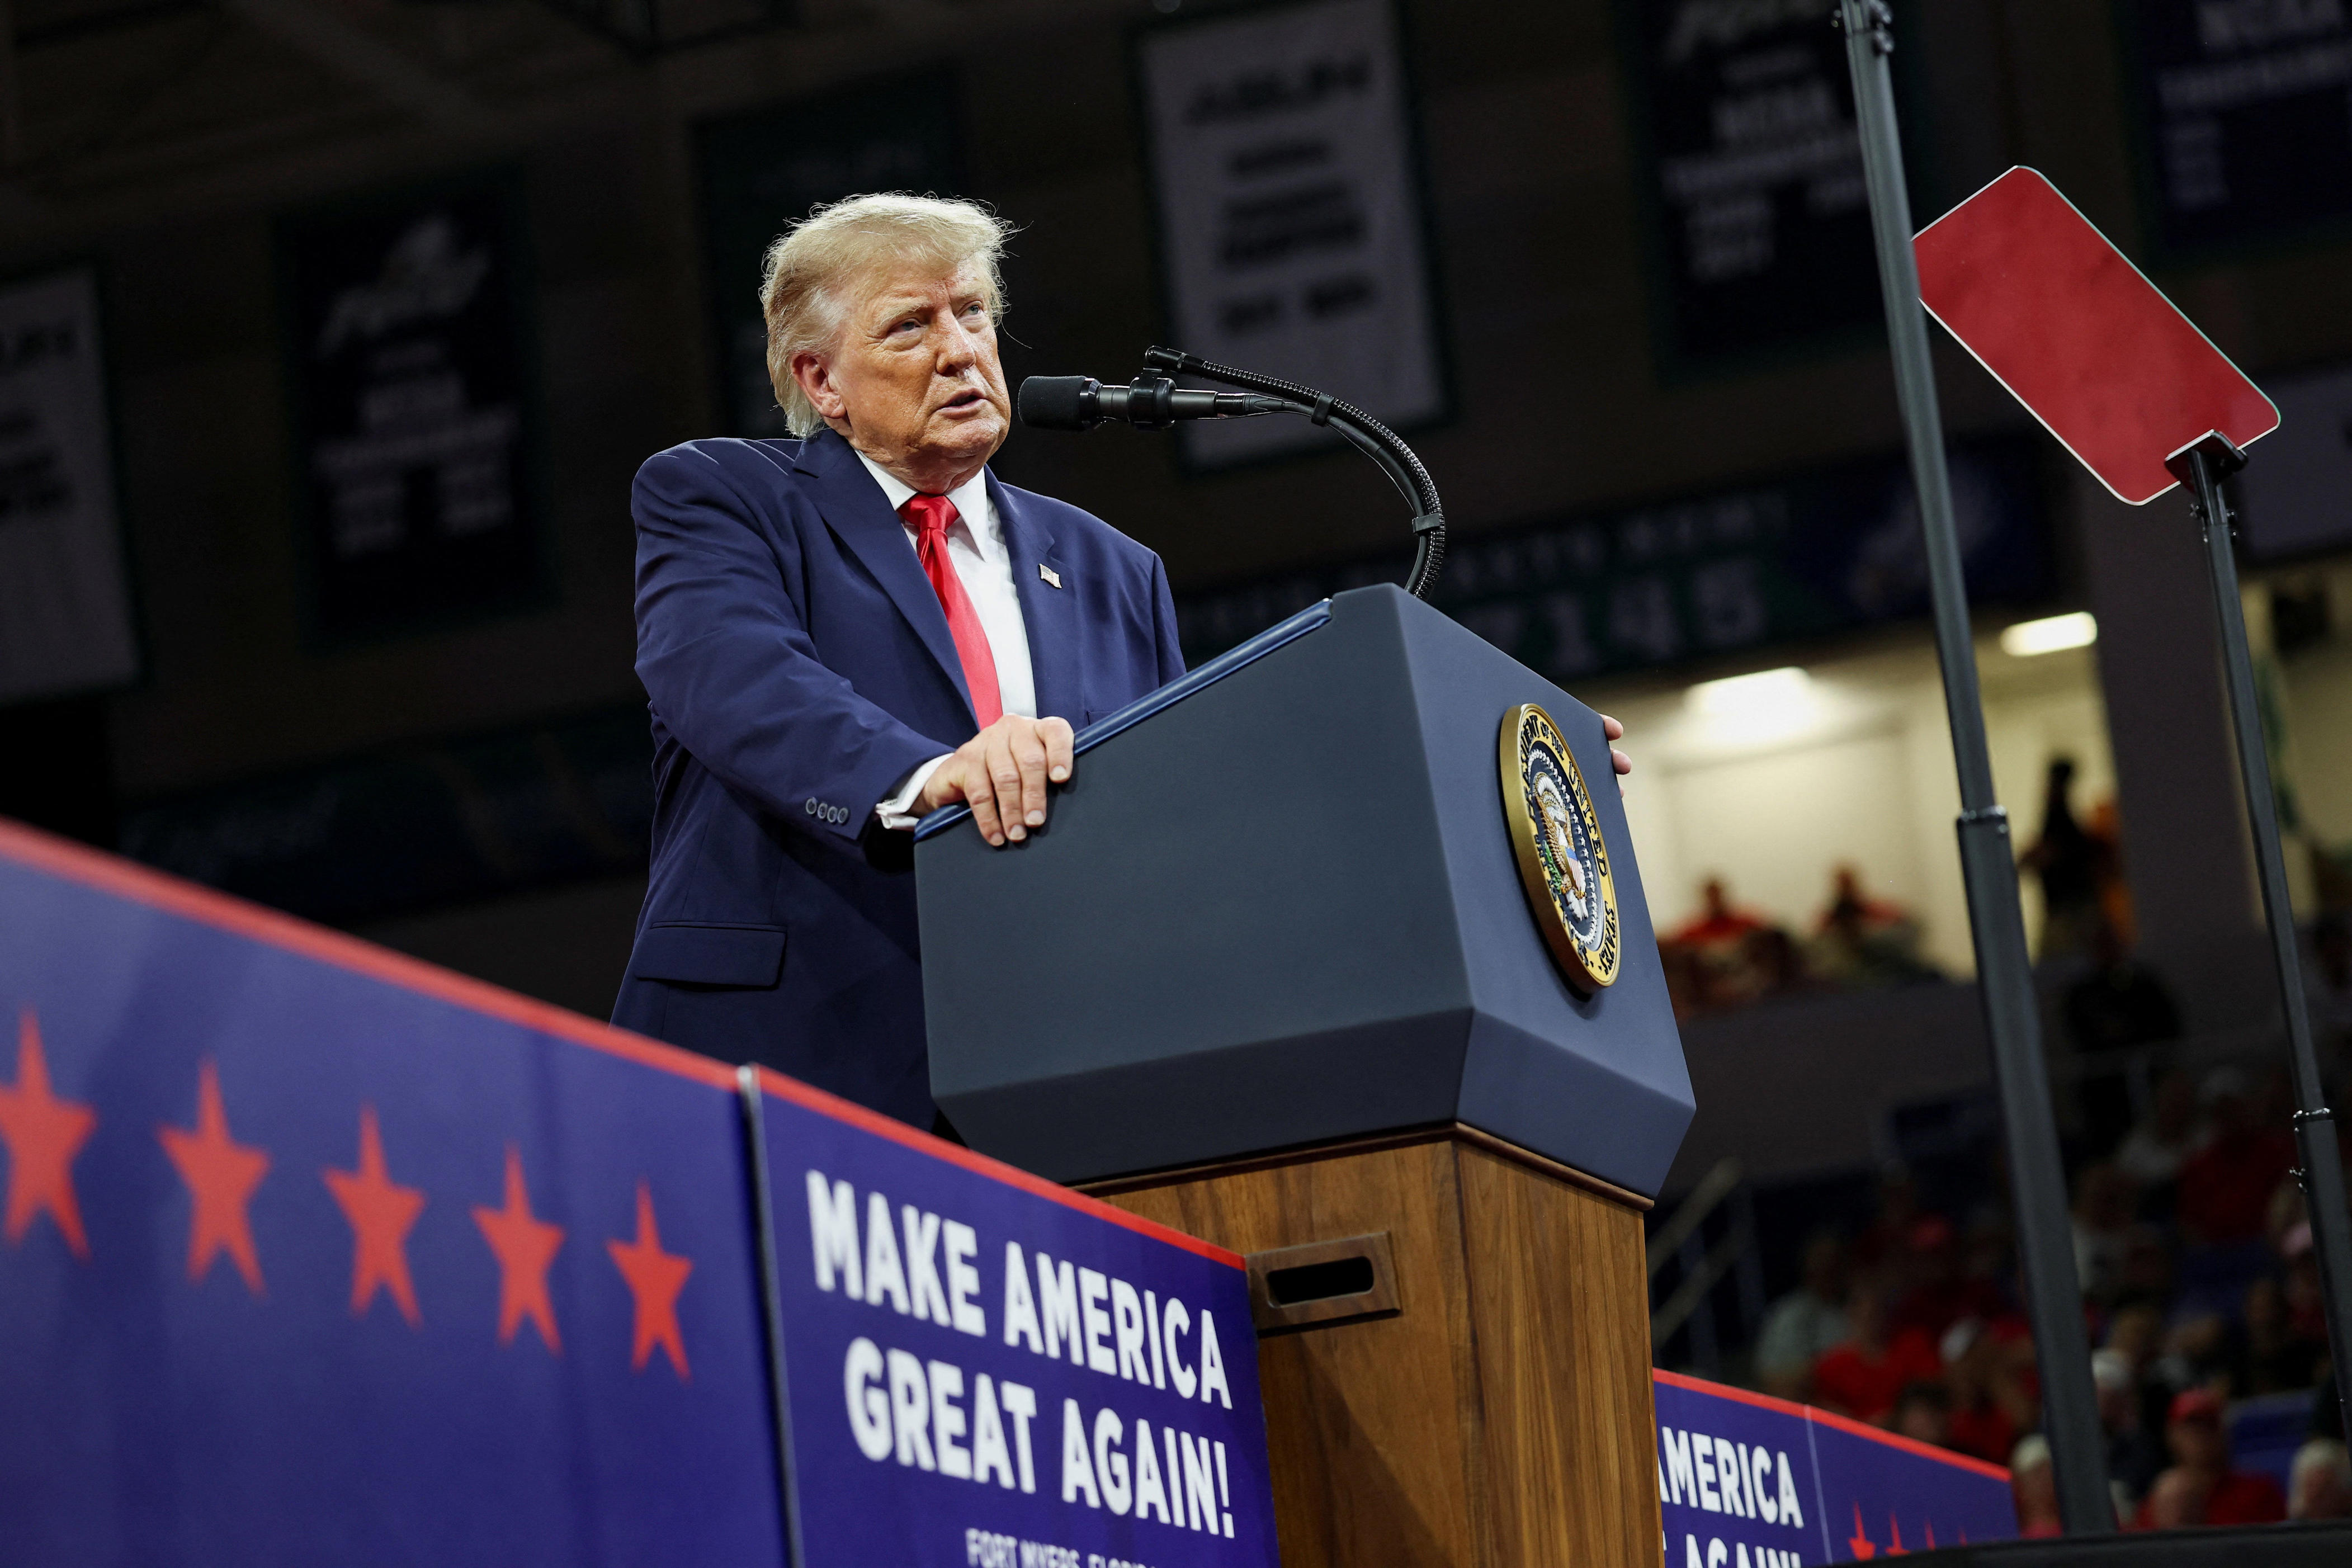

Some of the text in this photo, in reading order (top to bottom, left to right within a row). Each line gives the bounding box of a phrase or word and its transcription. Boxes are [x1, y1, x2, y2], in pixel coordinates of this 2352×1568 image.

[1569, 761, 1608, 877] UNITED
[1599, 900, 1616, 976] STATES
[805, 1169, 1234, 1410] MAKE AMERICA
[844, 1336, 1235, 1539] GREAT AGAIN!
